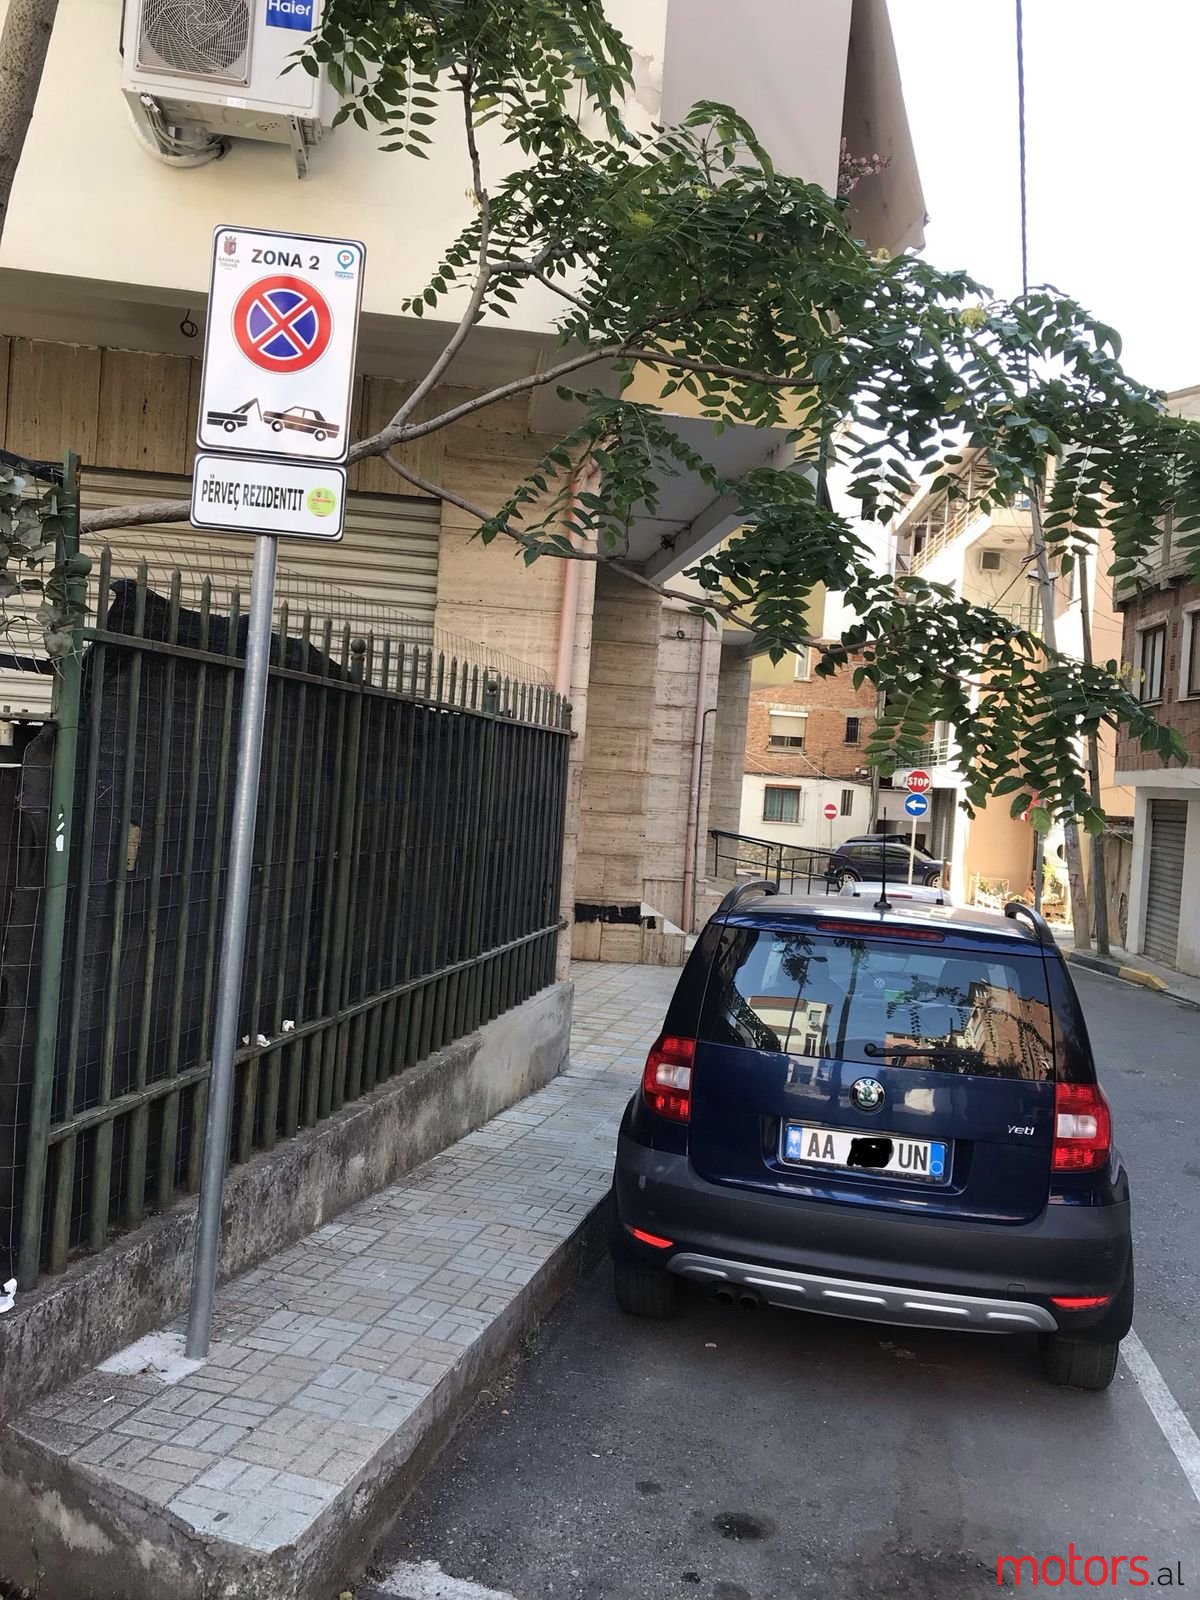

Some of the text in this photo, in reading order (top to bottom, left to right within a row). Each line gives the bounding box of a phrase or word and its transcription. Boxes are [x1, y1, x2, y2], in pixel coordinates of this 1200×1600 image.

[268, 0, 311, 16] Haier
[251, 248, 320, 271] ZONA 2
[201, 474, 304, 512] PËRVEÇ REZIDENTIT
[908, 776, 929, 788] STOP
[1007, 1124, 1035, 1136] Yeti
[806, 1132, 836, 1160] AA
[898, 1143, 928, 1172] UN
